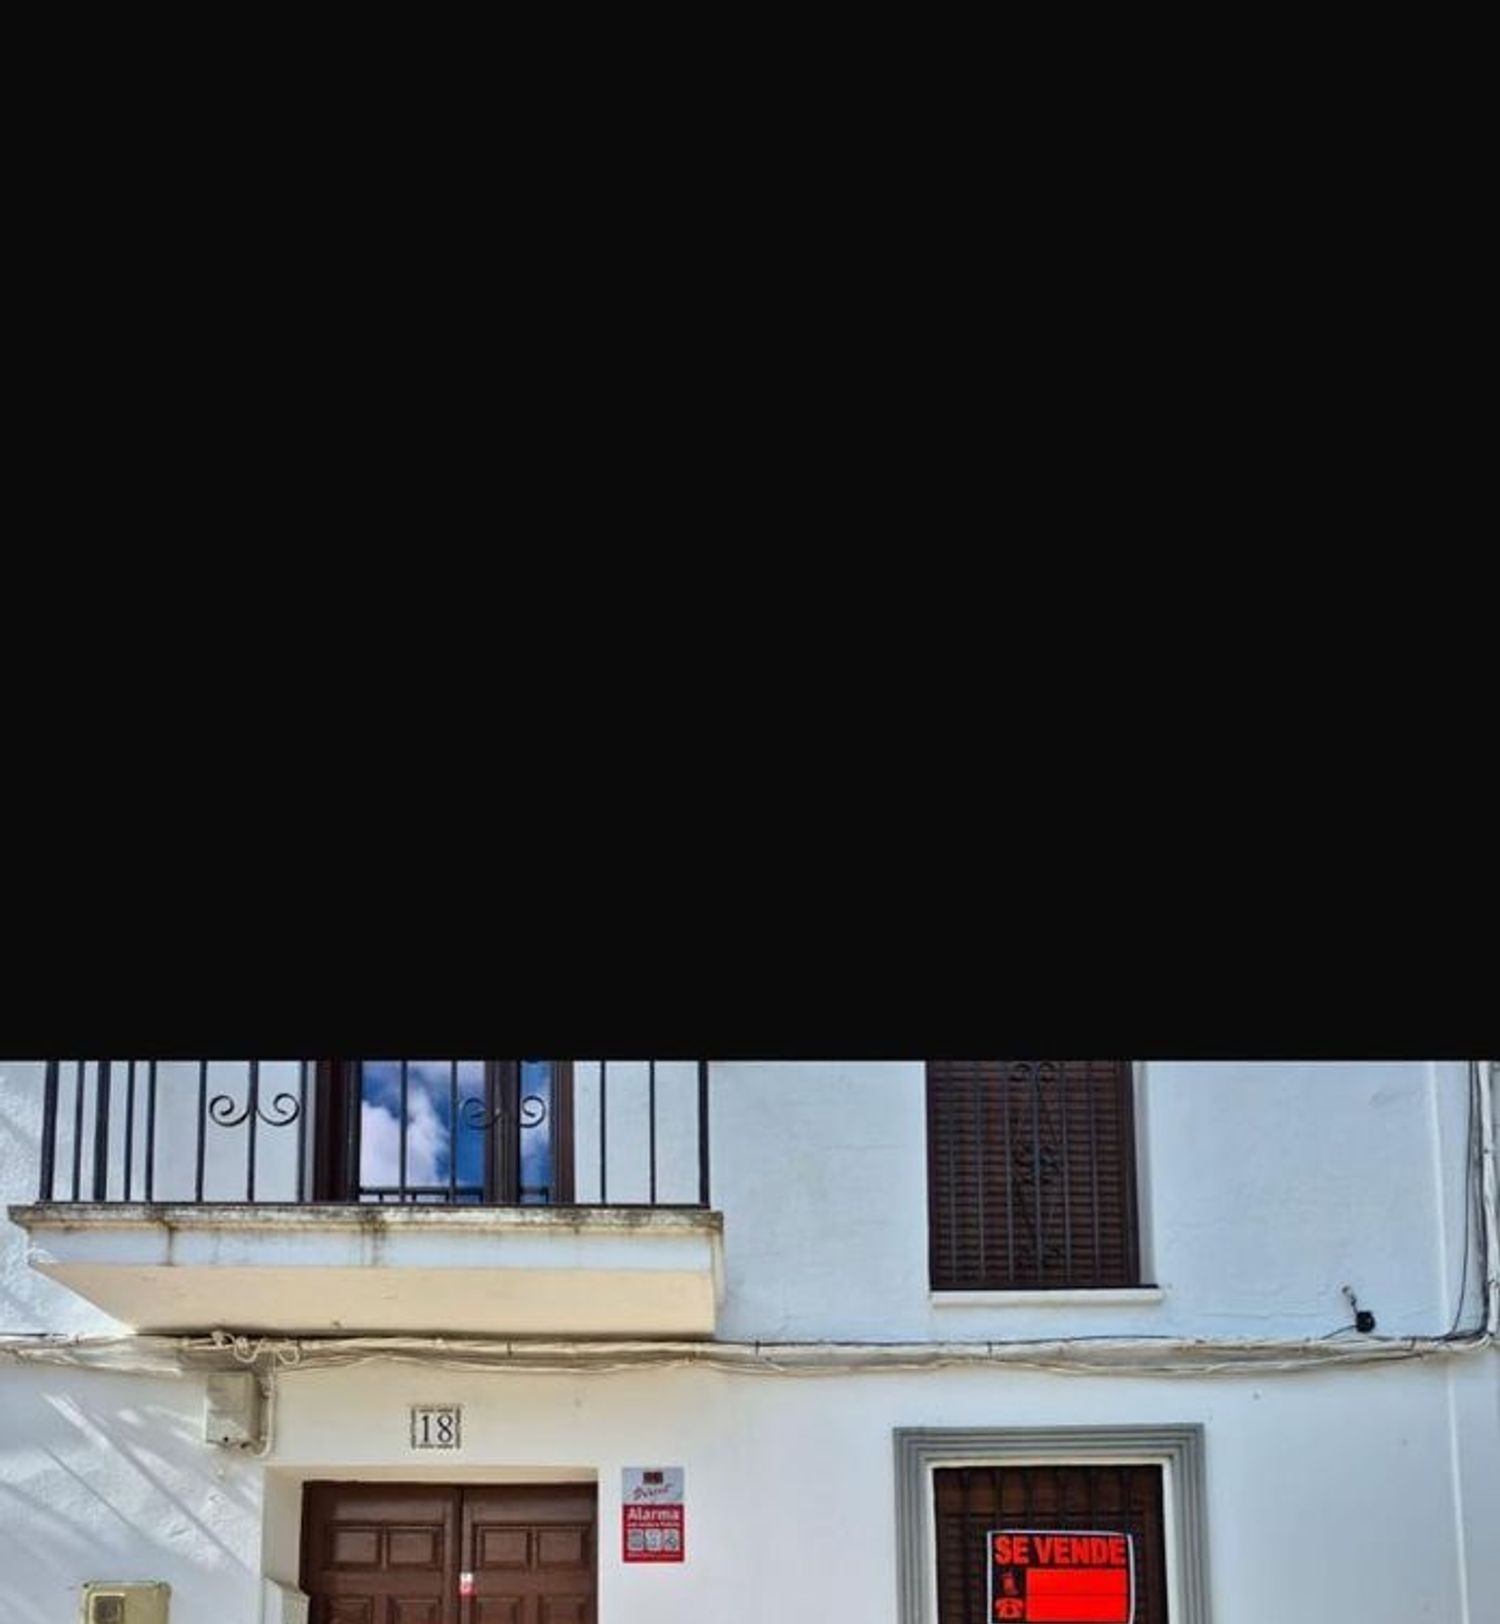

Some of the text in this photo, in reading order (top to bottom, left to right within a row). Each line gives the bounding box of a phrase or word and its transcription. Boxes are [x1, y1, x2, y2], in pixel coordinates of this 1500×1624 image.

[422, 1414, 453, 1443] 18
[627, 1507, 680, 1520] Alarma
[994, 1535, 1127, 1565] SE VENDE
